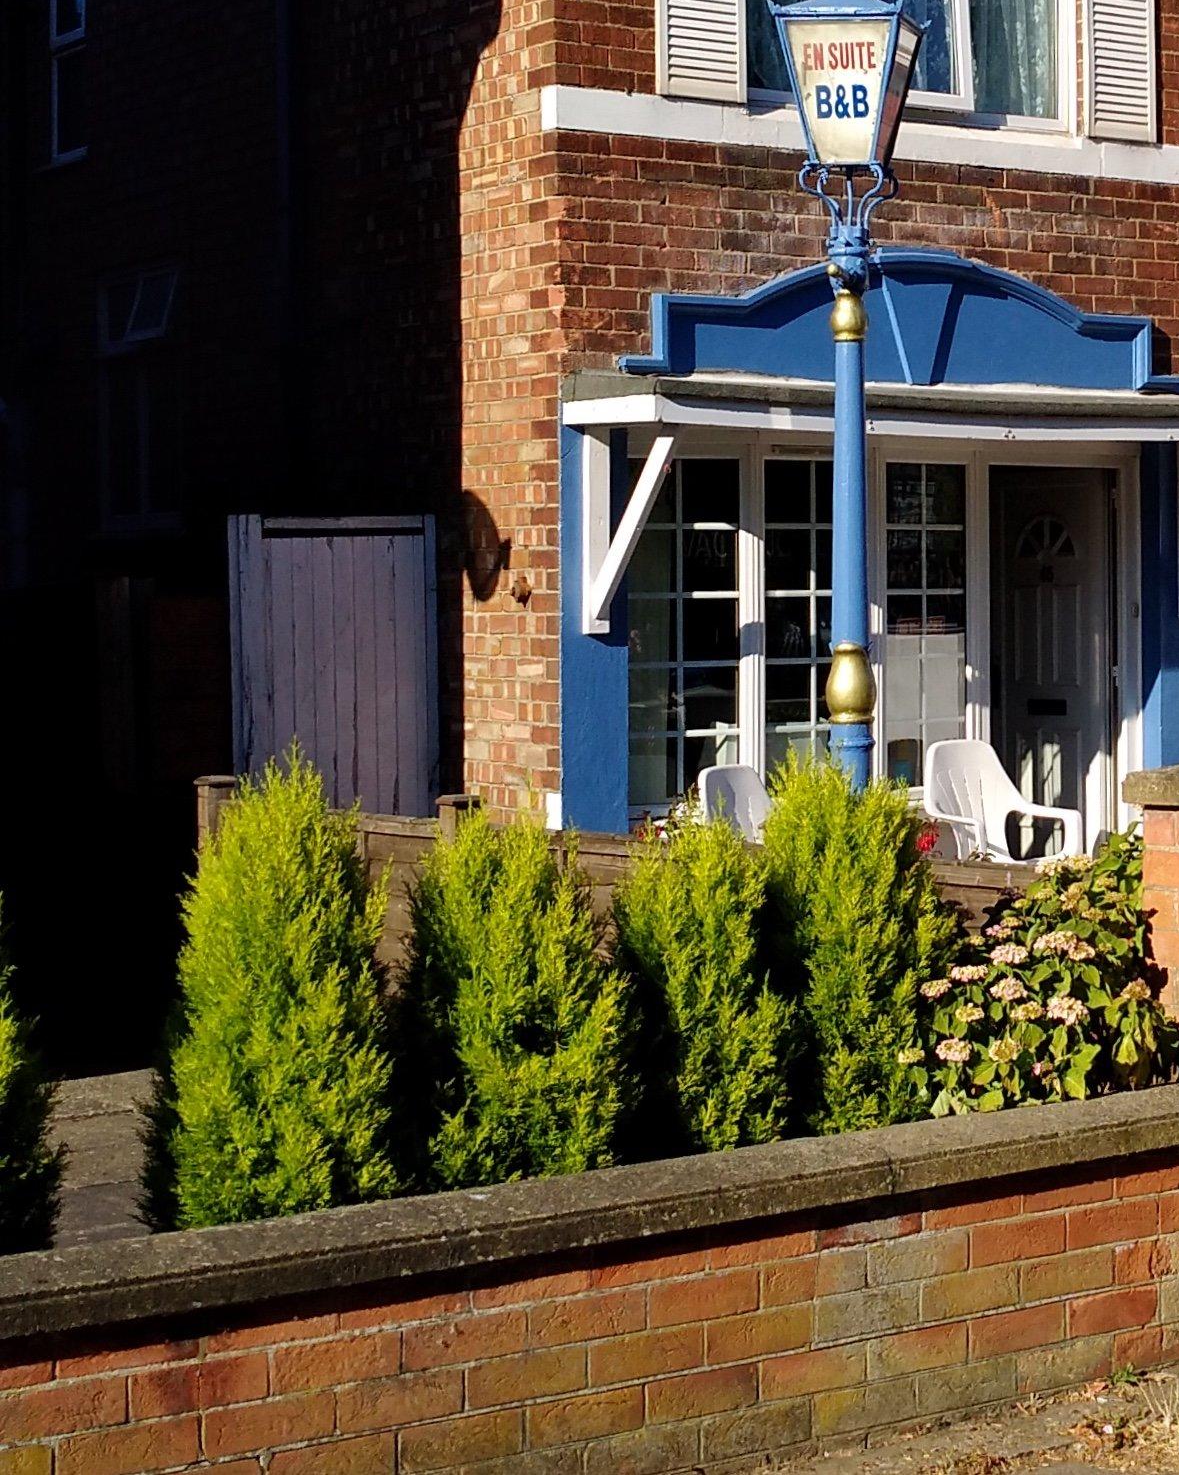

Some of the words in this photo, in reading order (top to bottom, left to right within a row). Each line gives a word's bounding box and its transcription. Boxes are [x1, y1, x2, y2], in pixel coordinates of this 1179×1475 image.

[803, 42, 824, 71] EN
[828, 41, 876, 70] SUITE
[815, 84, 869, 119] B&B
